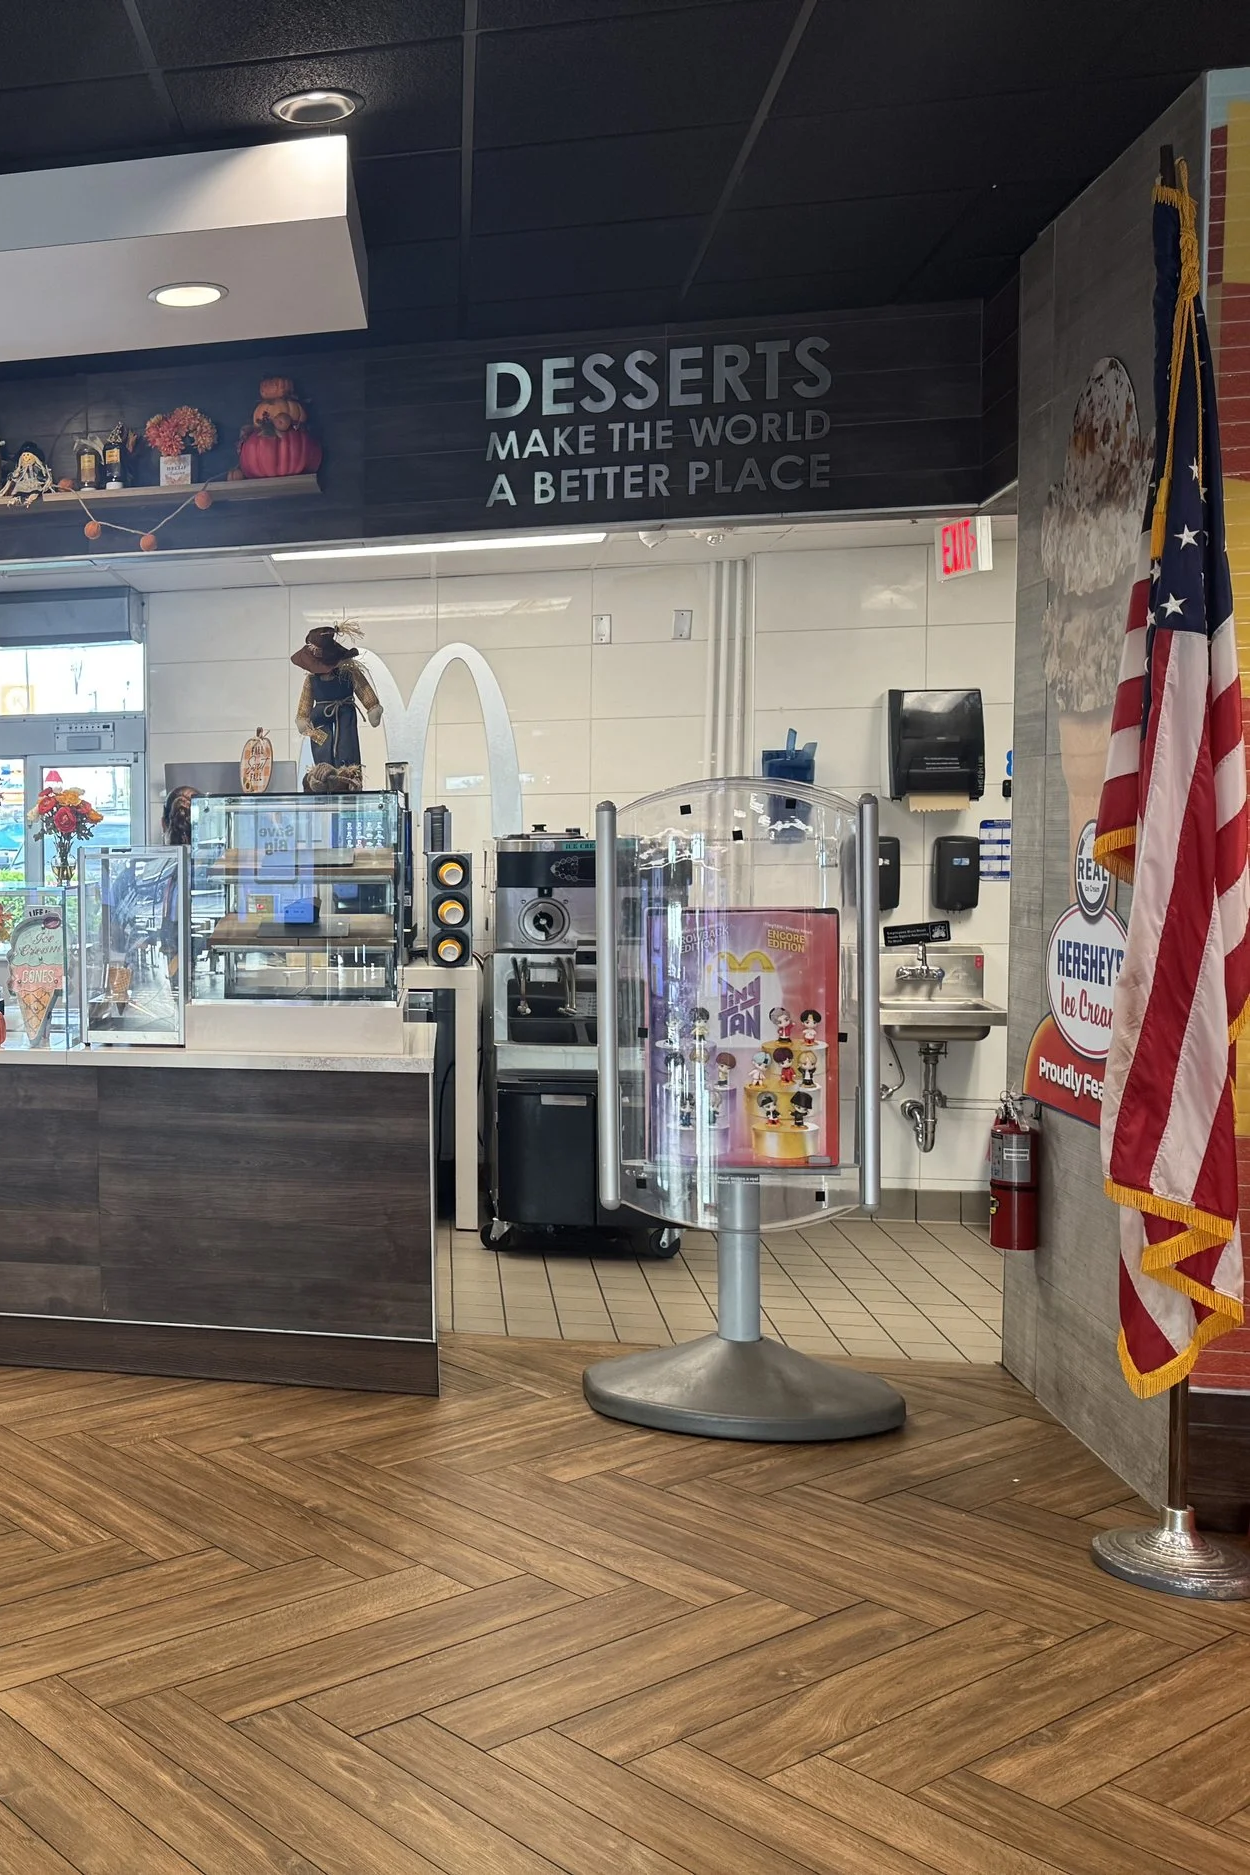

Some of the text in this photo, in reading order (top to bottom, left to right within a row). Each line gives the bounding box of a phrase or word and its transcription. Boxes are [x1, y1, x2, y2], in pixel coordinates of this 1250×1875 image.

[485, 337, 832, 420] DESSERTS
[486, 410, 830, 461] MAKE THE WORLD
[485, 454, 830, 507] A BETTER PLACE
[942, 519, 971, 574] EXIT
[1078, 858, 1108, 881] REAL
[767, 929, 806, 944] ENCORE
[767, 938, 806, 953] EDITION
[22, 970, 54, 984] CONES
[1061, 981, 1077, 1019] Ice
[718, 1004, 761, 1040] TAN
[1039, 1057, 1082, 1098] Proudly
